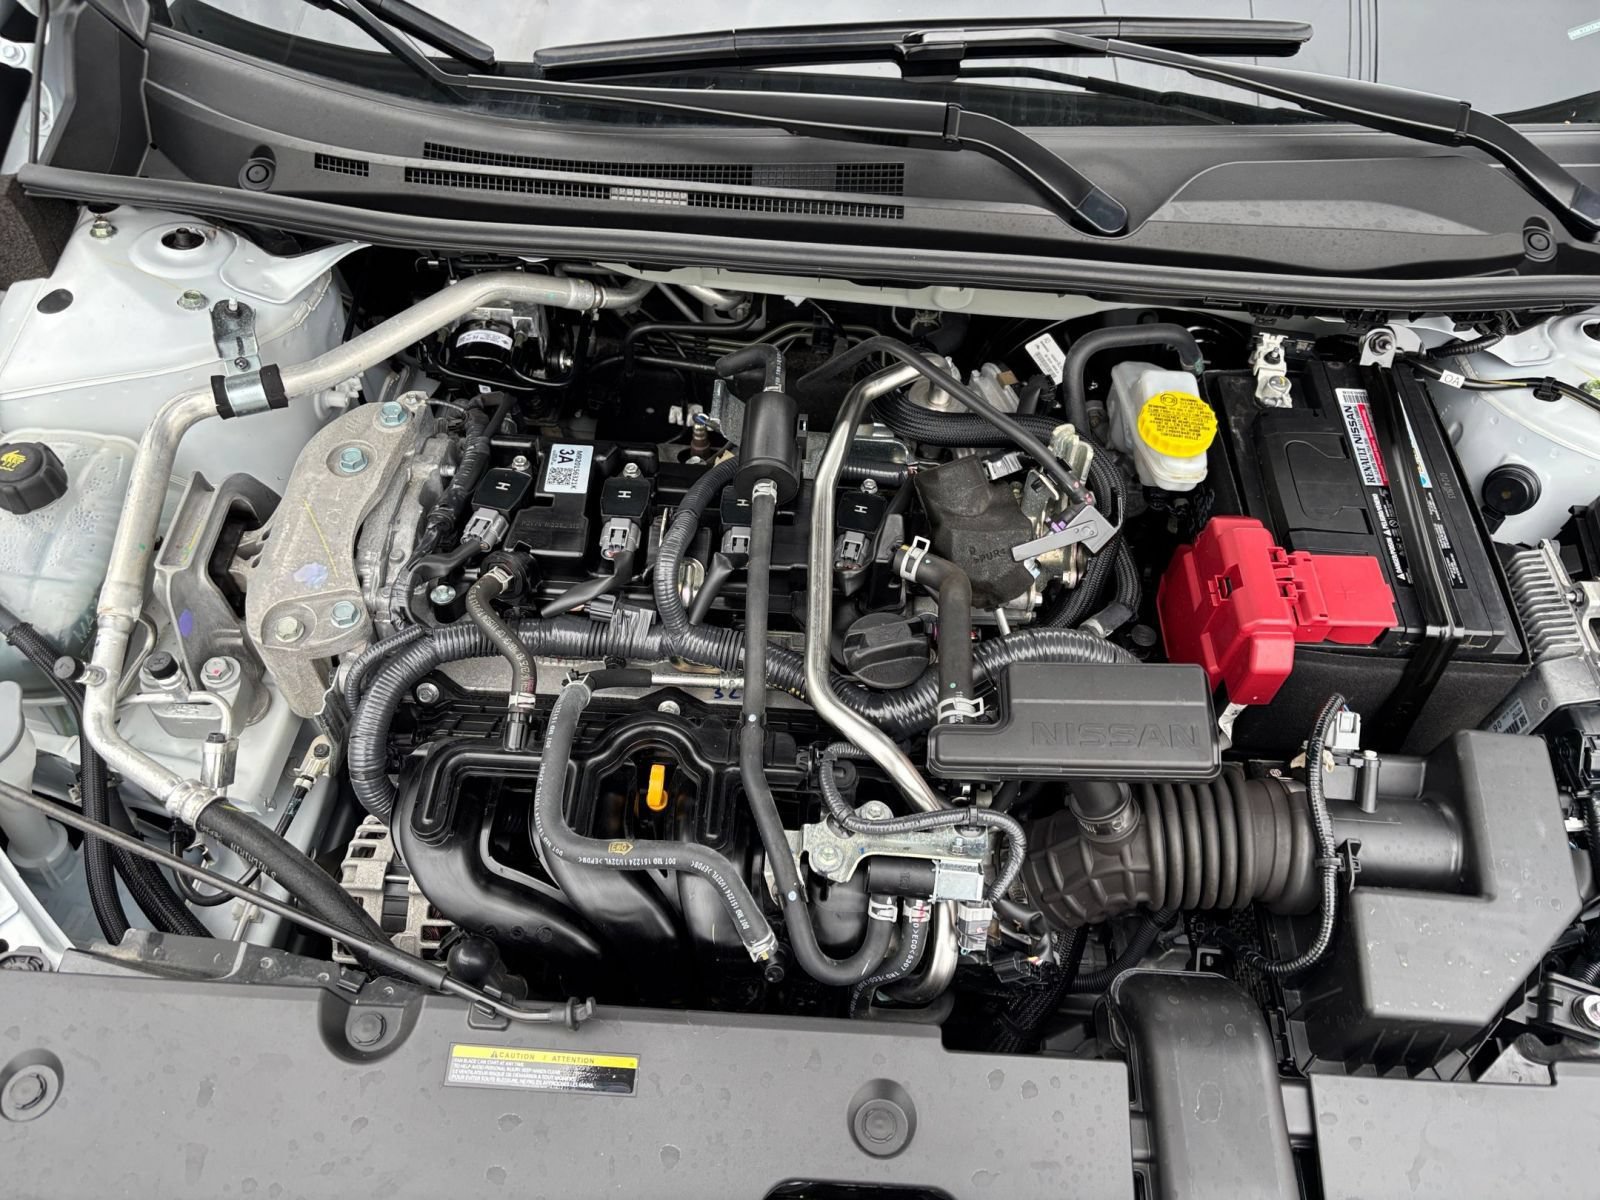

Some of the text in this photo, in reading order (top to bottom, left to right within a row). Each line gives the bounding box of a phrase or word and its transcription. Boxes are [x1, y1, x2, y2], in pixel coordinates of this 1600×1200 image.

[1344, 405, 1364, 445] NISSAN
[558, 449, 575, 464] 3A
[1359, 448, 1376, 484] RENAULT
[1031, 720, 1200, 748] NISSAN
[499, 1051, 535, 1060] CAUTION
[551, 1055, 595, 1064] ATTENTION
